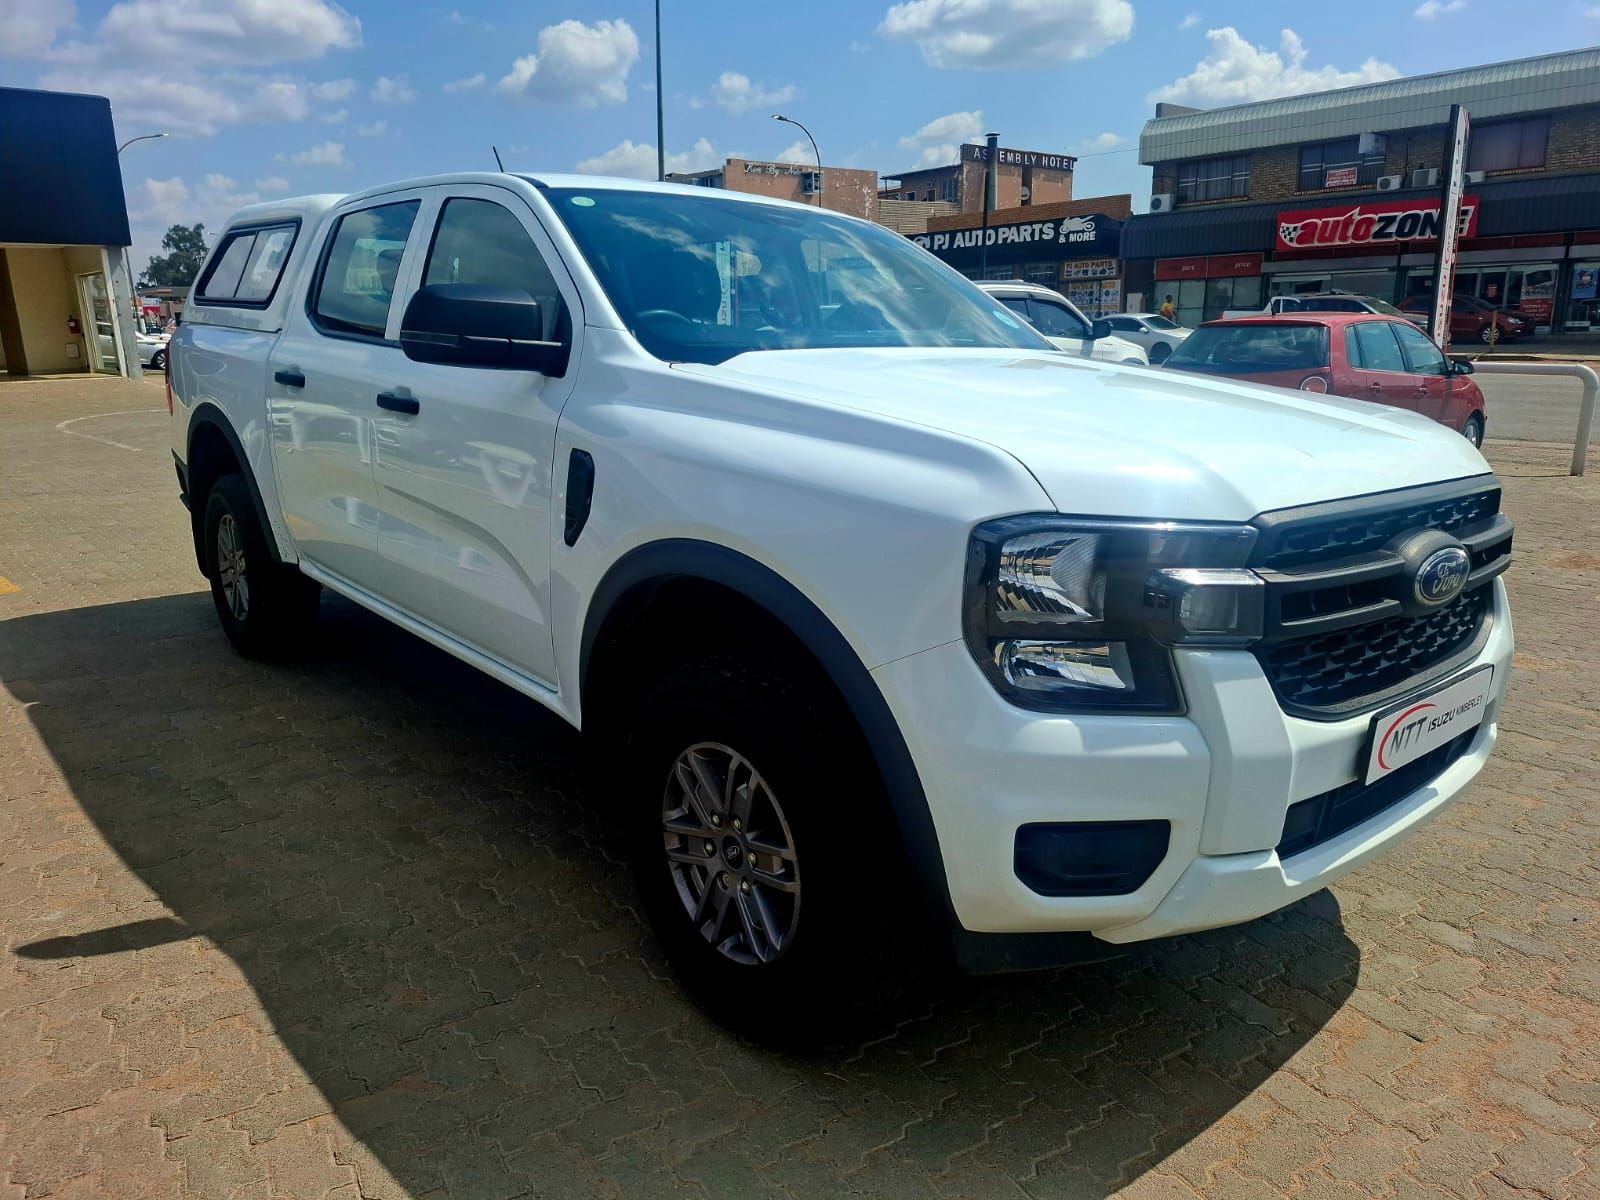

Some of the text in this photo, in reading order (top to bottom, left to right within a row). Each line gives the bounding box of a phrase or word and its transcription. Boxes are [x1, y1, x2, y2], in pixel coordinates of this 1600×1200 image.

[973, 147, 1074, 170] ASEMBLY HOTEL
[933, 223, 1055, 250] PJ AUTO PARTS
[1069, 231, 1096, 242] MORE
[1432, 561, 1462, 594] Ford
[1389, 716, 1428, 758] NTT
[1427, 708, 1456, 733] ISUZU
